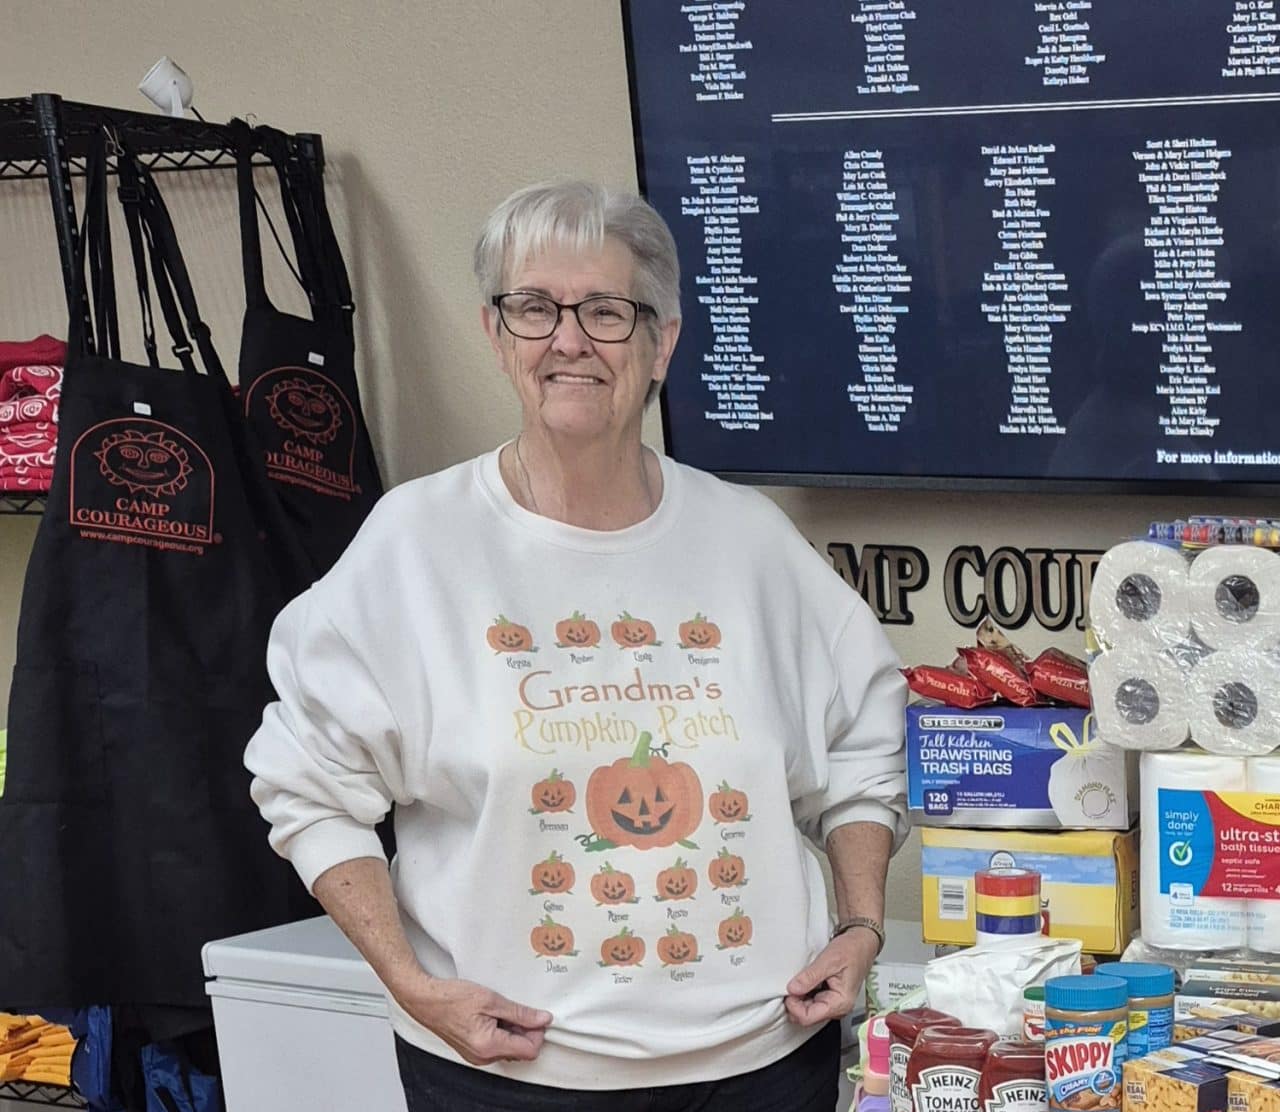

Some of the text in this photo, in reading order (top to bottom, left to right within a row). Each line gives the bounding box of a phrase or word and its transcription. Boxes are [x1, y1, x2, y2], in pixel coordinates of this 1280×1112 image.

[283, 440, 324, 463] CAMP
[1157, 451, 1178, 463] For
[1181, 454, 1212, 463] more
[264, 452, 350, 485] OURAGEOUS
[116, 496, 170, 517] CAMP
[76, 508, 208, 540] COURAGEOUS
[828, 543, 929, 626] MP
[519, 667, 723, 711] Grandma's
[513, 704, 740, 754] Pumpkin Patch
[922, 717, 1001, 729] STEELCOAT
[919, 735, 993, 749] Tall Kitchen
[920, 749, 1012, 763] DRAWSTRING
[921, 762, 1012, 776] TRASH BAGS
[928, 792, 948, 803] 120
[928, 802, 949, 811] BAGS
[1165, 811, 1199, 825] simply
[1167, 820, 1194, 832] done
[1221, 842, 1280, 854] bath tissue
[1221, 883, 1232, 893] 12
[892, 1052, 909, 1067] HEIN
[1046, 1040, 1113, 1082] SKIPPY
[932, 1075, 973, 1090] HEINZ
[1060, 1077, 1090, 1097] CREAMY
[925, 1096, 981, 1110] TOMATO
[1006, 1089, 1046, 1103] HEINZ
